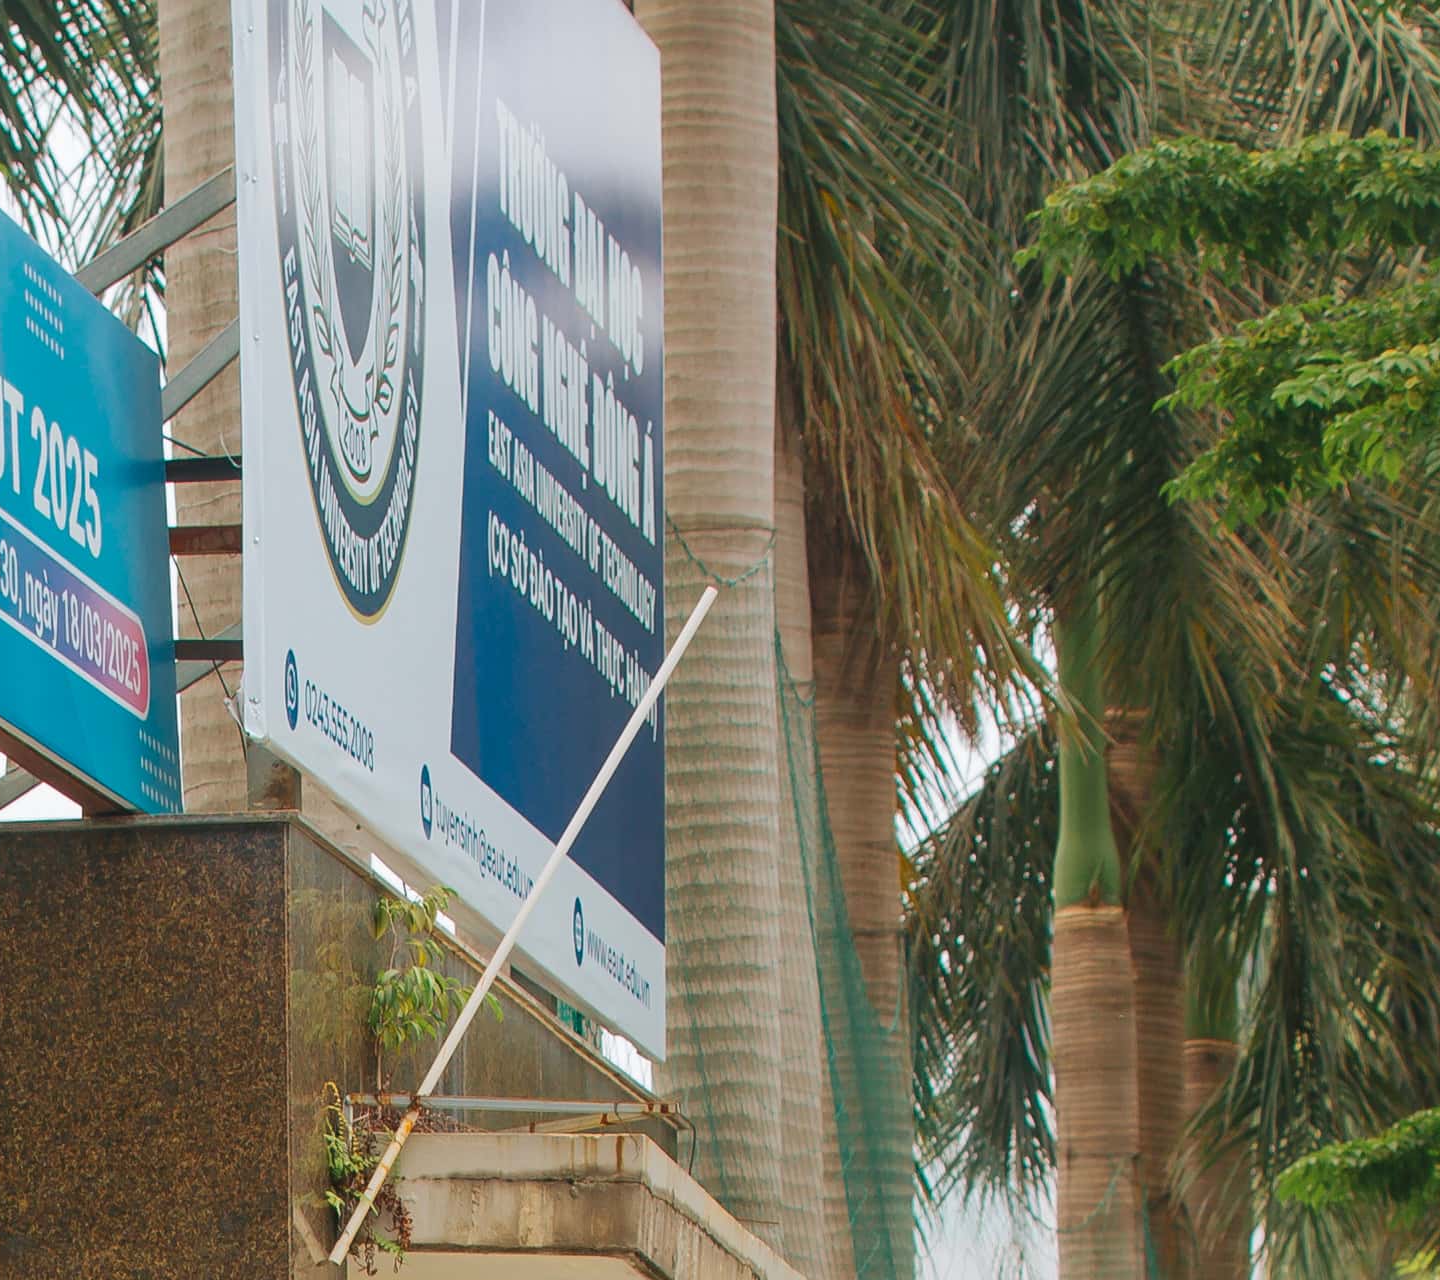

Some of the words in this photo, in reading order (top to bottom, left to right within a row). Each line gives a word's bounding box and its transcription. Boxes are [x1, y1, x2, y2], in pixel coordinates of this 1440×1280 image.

[574, 190, 606, 343] ĐẠI
[608, 234, 645, 380] HỌC
[30, 405, 103, 560] 2025
[283, 245, 308, 368] EAST
[299, 364, 320, 480] ASIA
[319, 461, 369, 593] UNIVERSITY
[369, 538, 382, 594] OF
[379, 367, 419, 592] TECHNOLOGY
[342, 410, 368, 468] 2008
[487, 249, 540, 416] CÔNG
[542, 313, 591, 491] NGHỆ
[593, 370, 641, 529] ĐÔNG
[643, 420, 657, 547] Á
[488, 410, 513, 483] EAST
[513, 436, 536, 507] ASIA
[536, 460, 589, 564] UNIVERSITY
[589, 516, 602, 575] OF
[601, 532, 657, 636] TECHNOLOGY
[488, 510, 511, 579] (CƠ
[511, 530, 530, 597] SỞ
[529, 548, 555, 623] ĐÀO
[554, 576, 579, 652] TẠO
[579, 597, 596, 667] VÀ
[595, 620, 626, 700] THỰC
[24, 566, 60, 650] ngày
[61, 589, 142, 698] 18/03/2025
[304, 679, 375, 774] 0243.555.2008
[586, 926, 653, 1012] www.eaut.edu.vn
